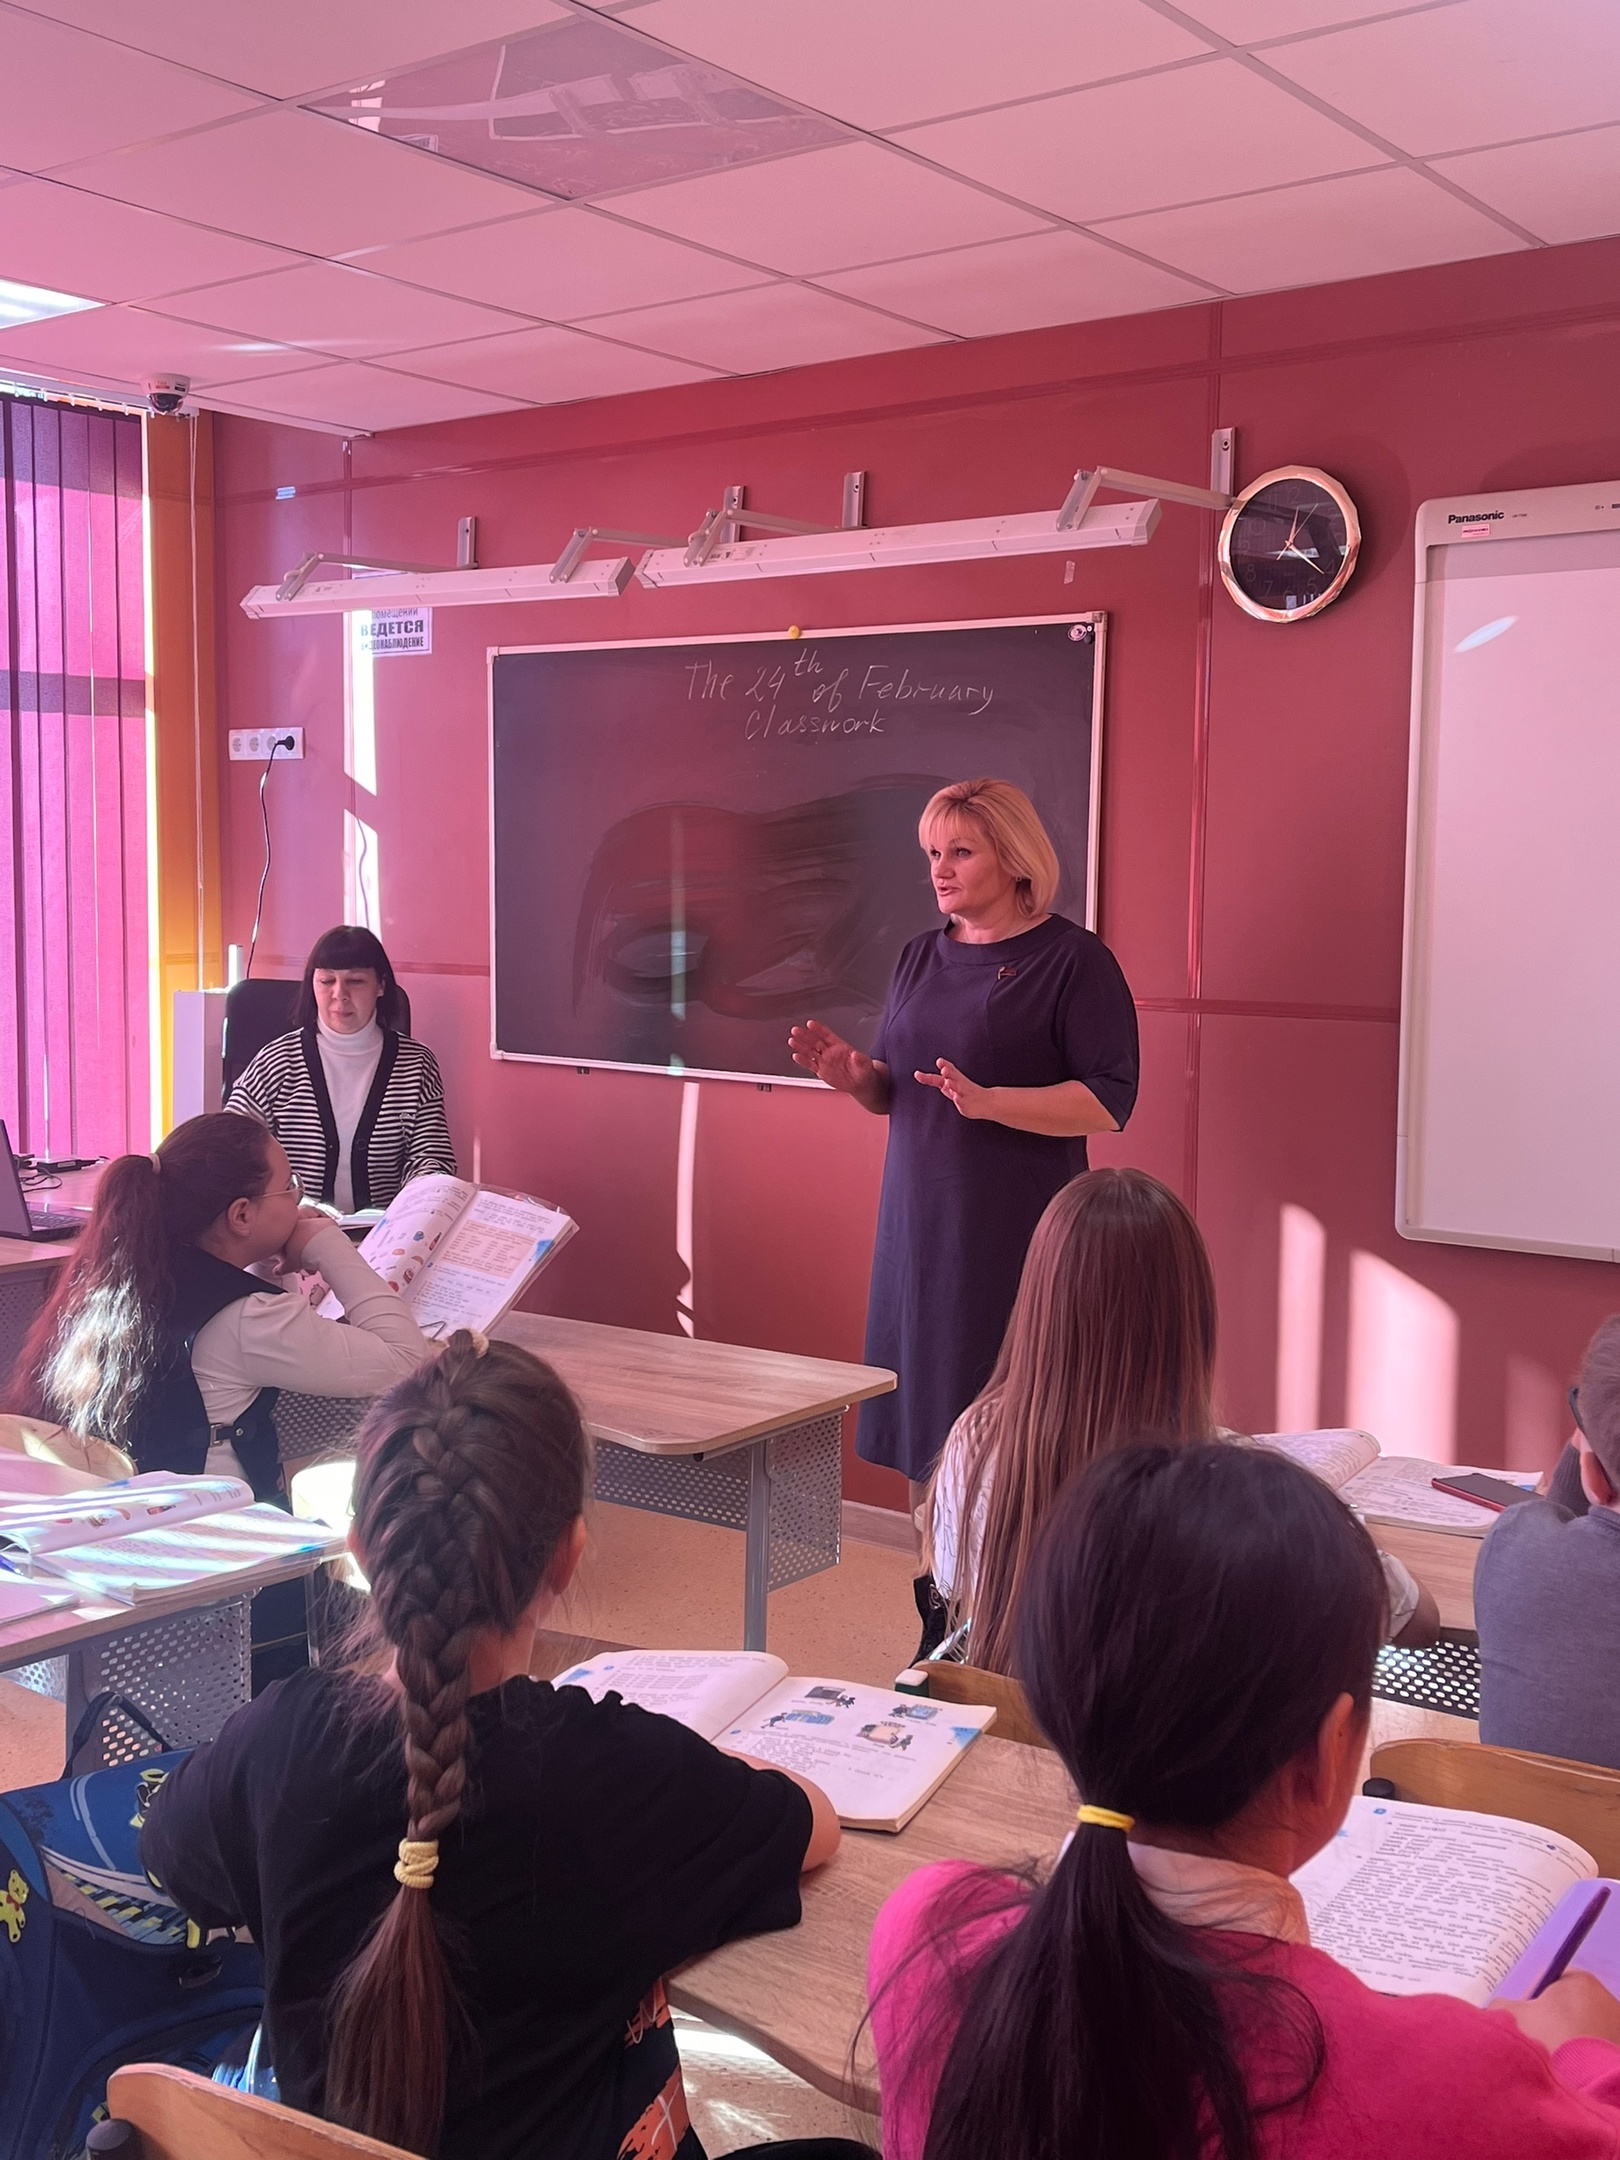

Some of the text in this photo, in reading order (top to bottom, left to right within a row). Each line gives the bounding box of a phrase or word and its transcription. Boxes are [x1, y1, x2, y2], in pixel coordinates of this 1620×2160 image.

[1448, 510, 1505, 524] Panasonic
[361, 620, 424, 637] ВЕДЕТСЯ
[361, 637, 424, 650] ДЕОНАБЛЮДЕНИЕ
[685, 660, 734, 701] The
[812, 668, 848, 713] of
[858, 665, 994, 716] February
[745, 704, 886, 740] Classwork
